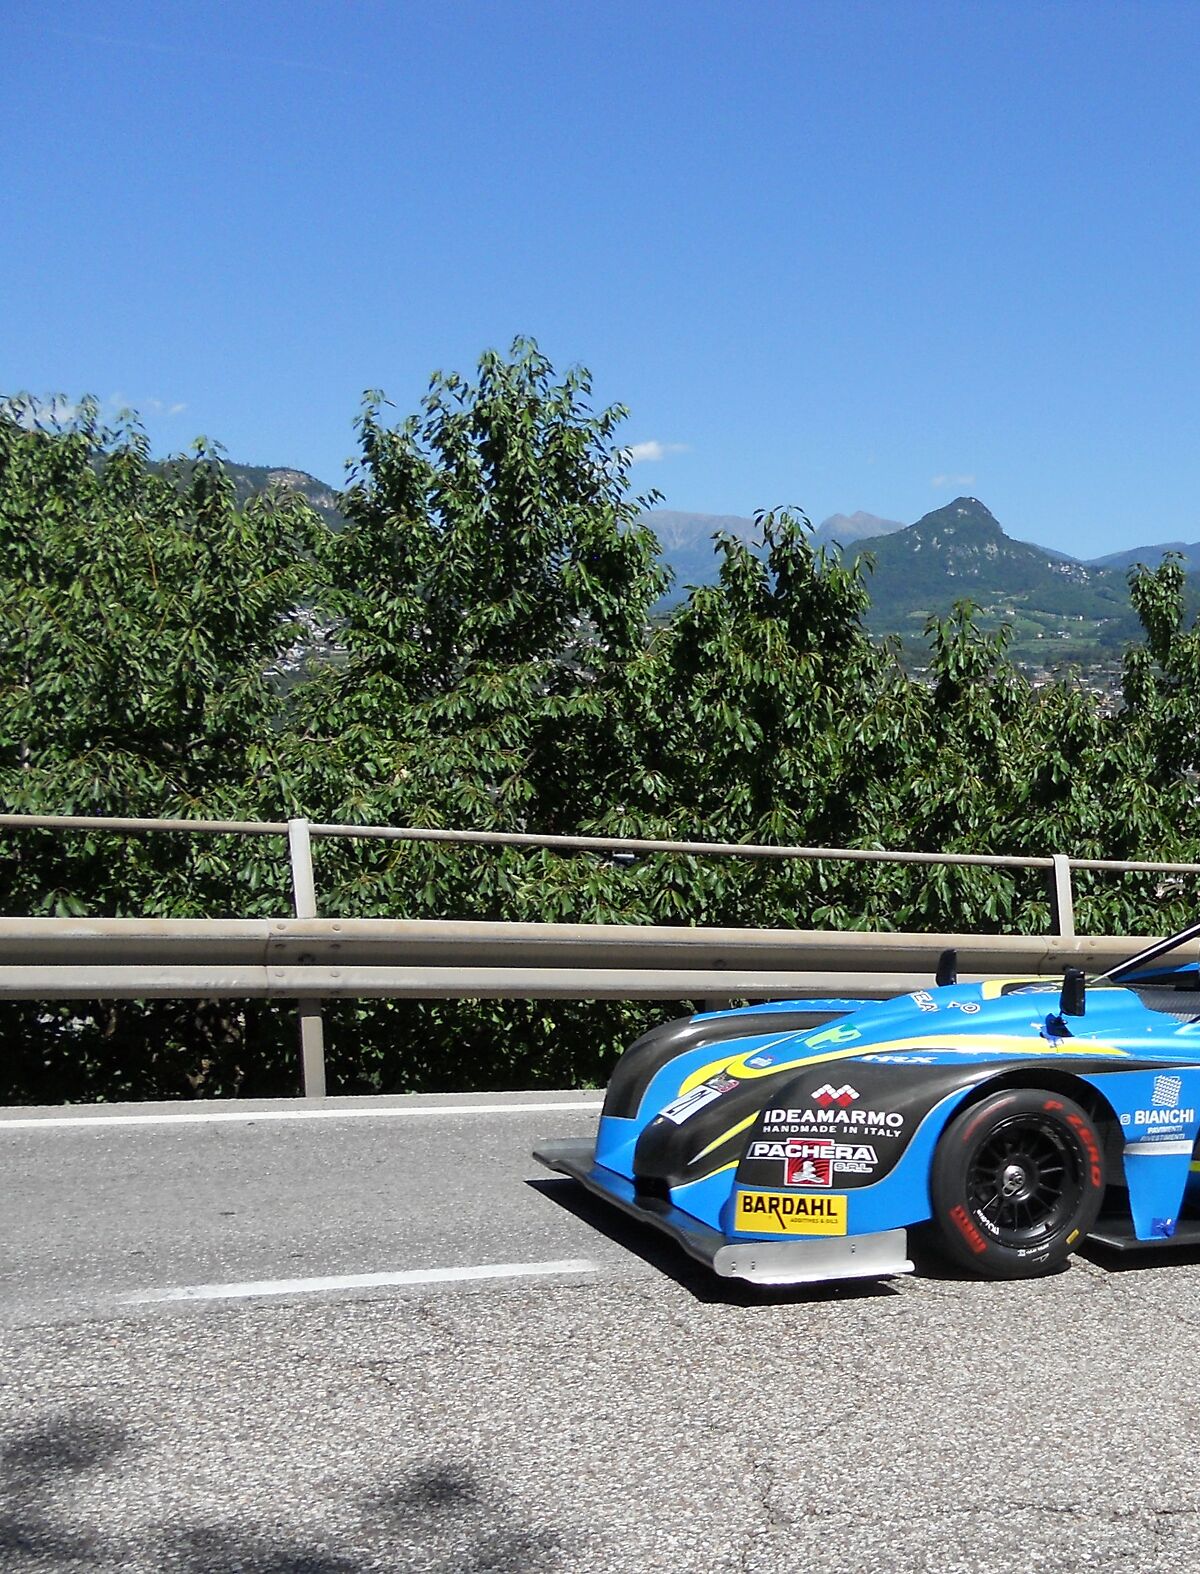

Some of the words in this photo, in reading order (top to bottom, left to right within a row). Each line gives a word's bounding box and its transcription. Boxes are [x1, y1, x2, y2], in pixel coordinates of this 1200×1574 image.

[763, 1109, 904, 1128] IDEAMARMO
[1134, 1108, 1194, 1125] BIANCHI
[763, 1125, 837, 1133] HANDMADE
[843, 1126, 858, 1134] IN
[864, 1127, 902, 1138] ITALY
[753, 1143, 873, 1162] PACHERA
[742, 1195, 838, 1229] BARDAHL
